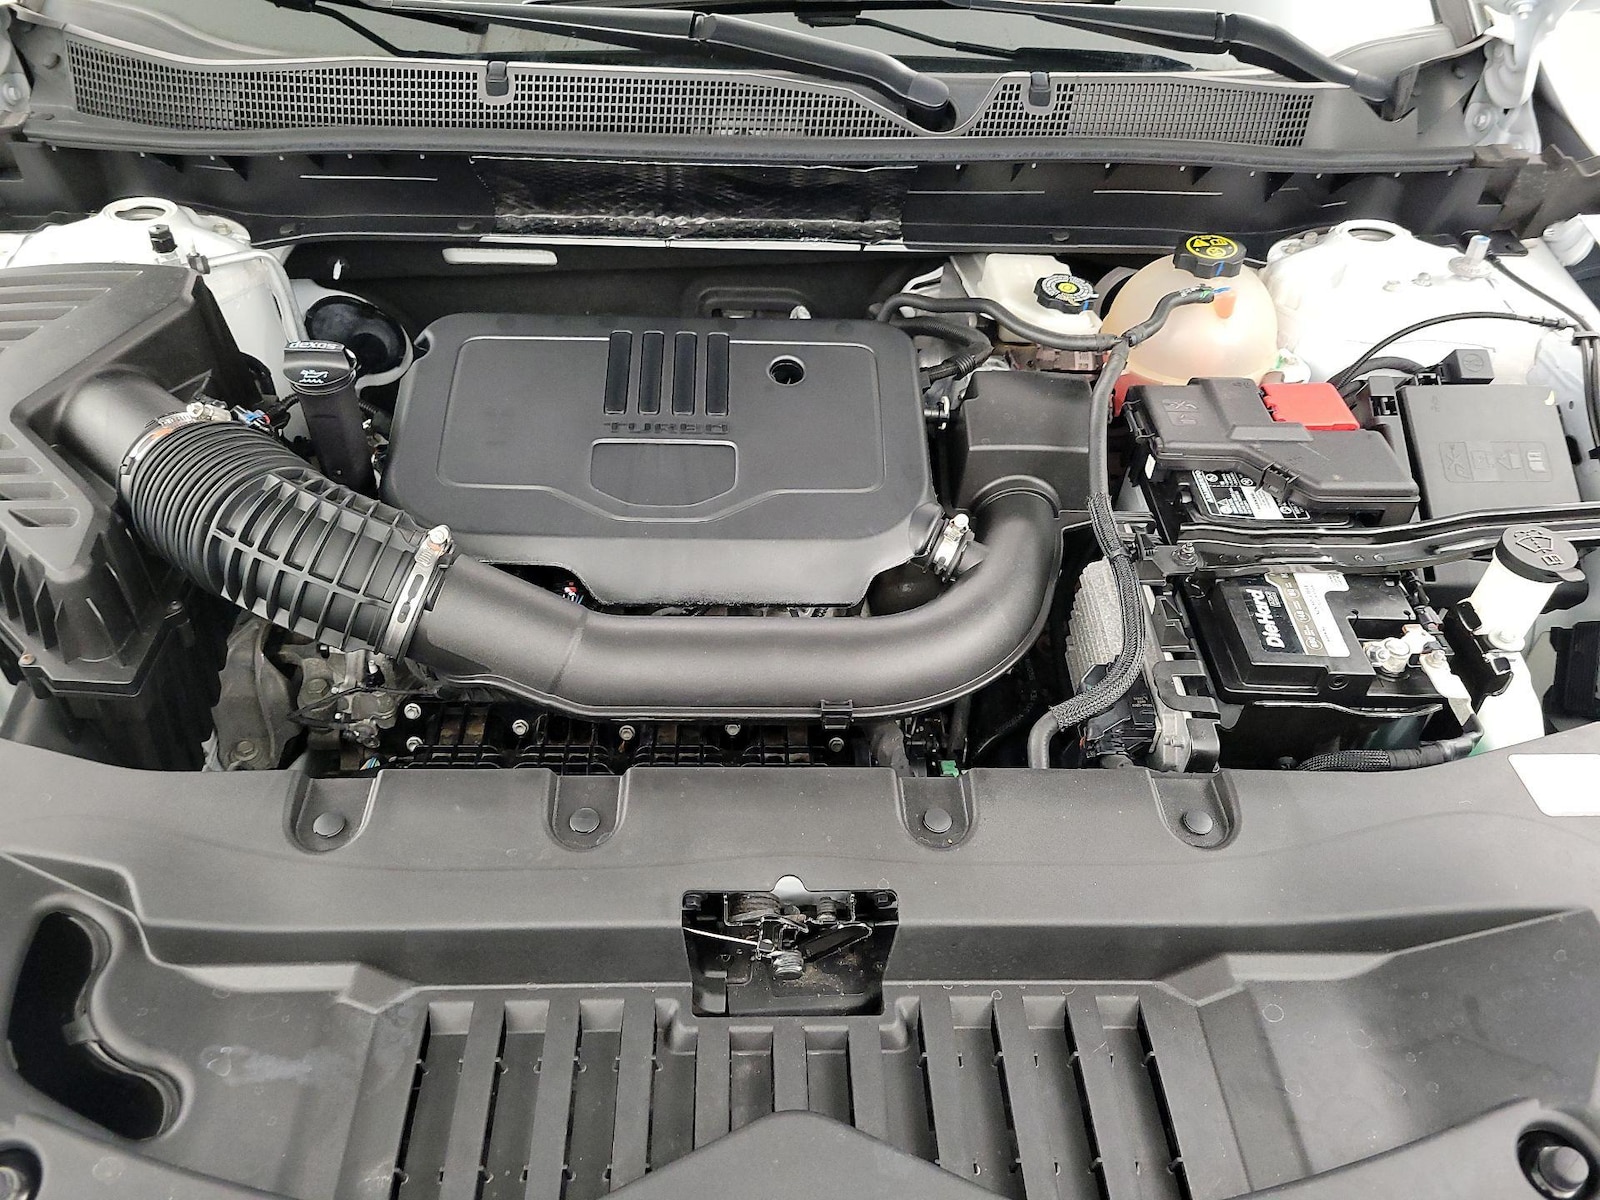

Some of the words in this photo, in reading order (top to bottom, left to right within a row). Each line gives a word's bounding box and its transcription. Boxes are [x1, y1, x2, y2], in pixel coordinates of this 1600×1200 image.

[289, 340, 341, 350] dexos
[603, 422, 729, 435] TURBO
[1246, 588, 1285, 648] DieHard
